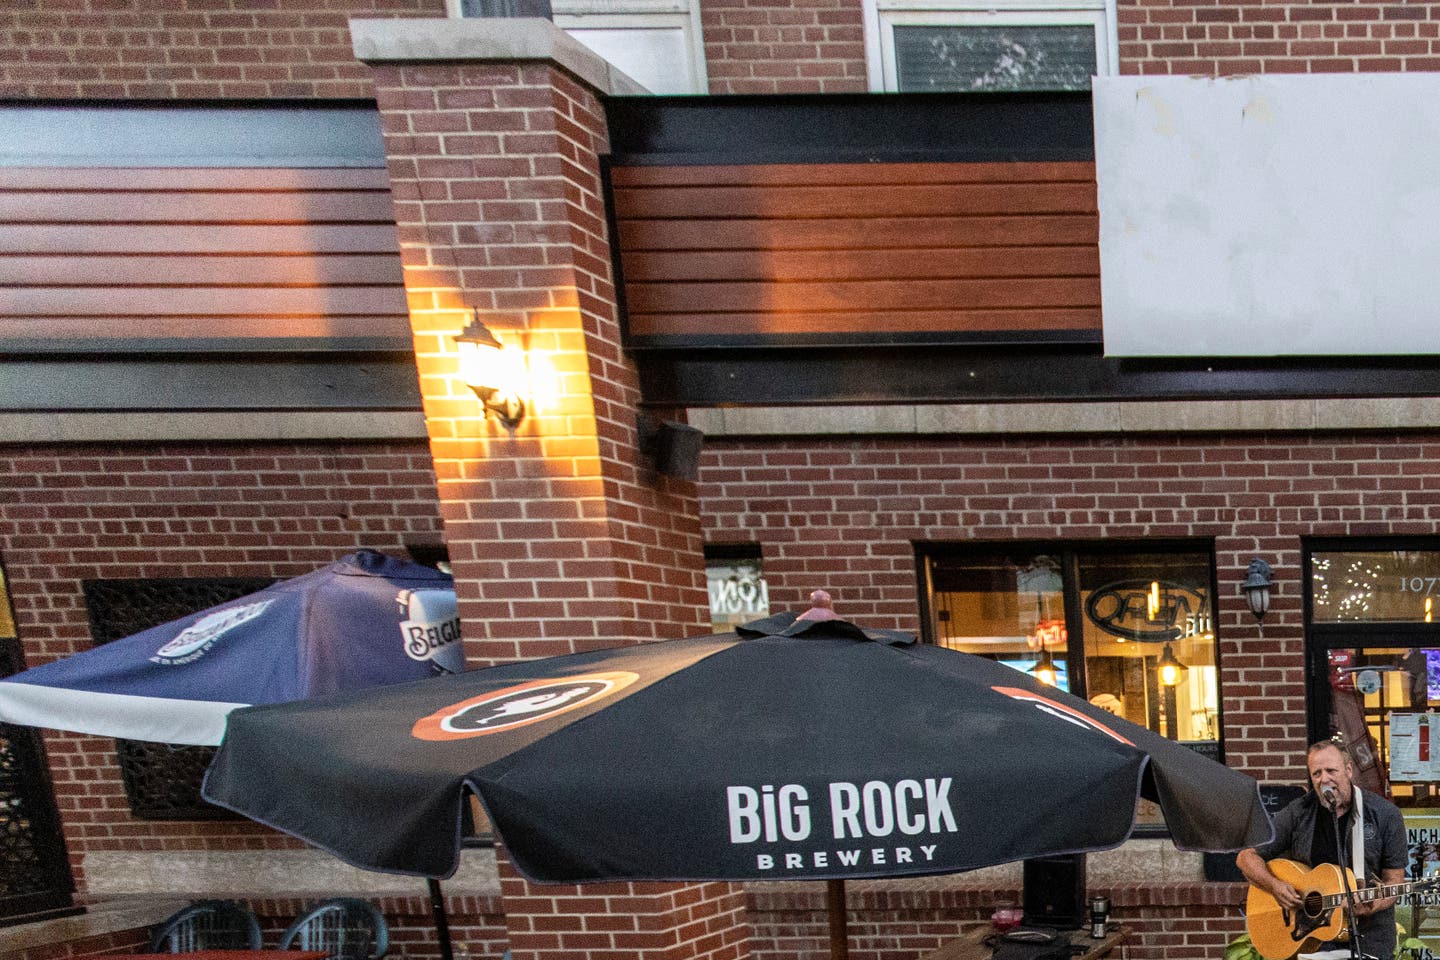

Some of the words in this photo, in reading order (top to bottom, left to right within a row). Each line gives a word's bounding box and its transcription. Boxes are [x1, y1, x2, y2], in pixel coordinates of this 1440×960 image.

[408, 618, 461, 657] BELGI
[828, 777, 959, 840] ROCK
[1408, 828, 1439, 844] NCH
[756, 844, 938, 870] BREWERY
